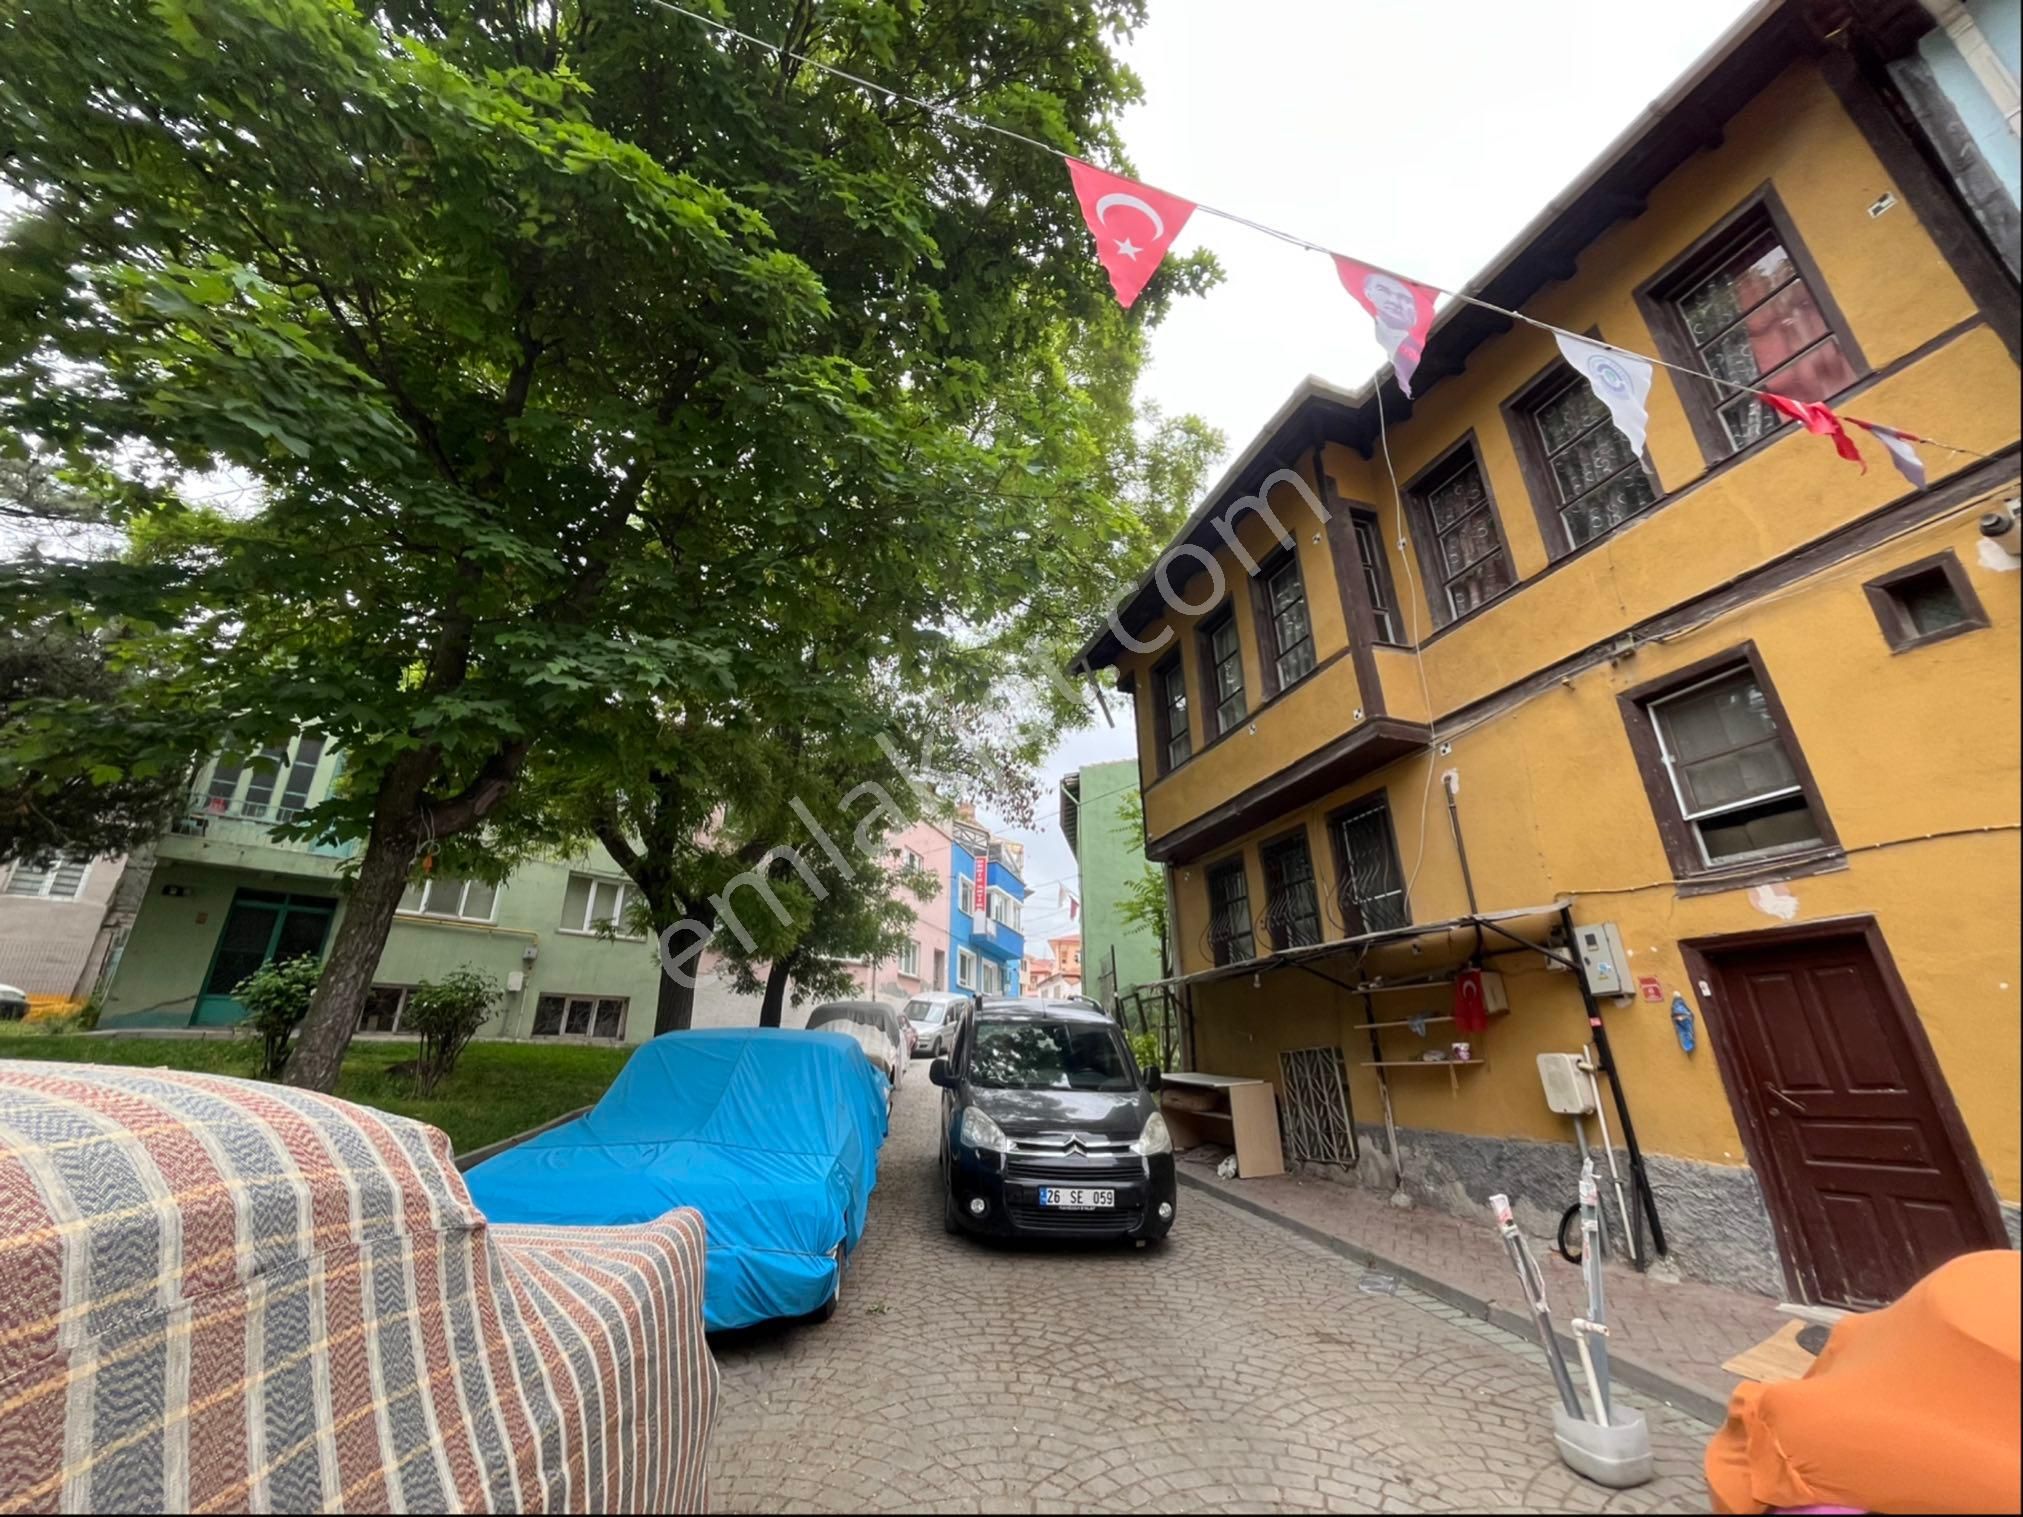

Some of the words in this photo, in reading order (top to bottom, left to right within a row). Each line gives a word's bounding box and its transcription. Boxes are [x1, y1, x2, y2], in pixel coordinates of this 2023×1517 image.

[1047, 1189, 1060, 1204] 26
[1070, 1190, 1083, 1204] SE
[1093, 1191, 1113, 1205] 059
